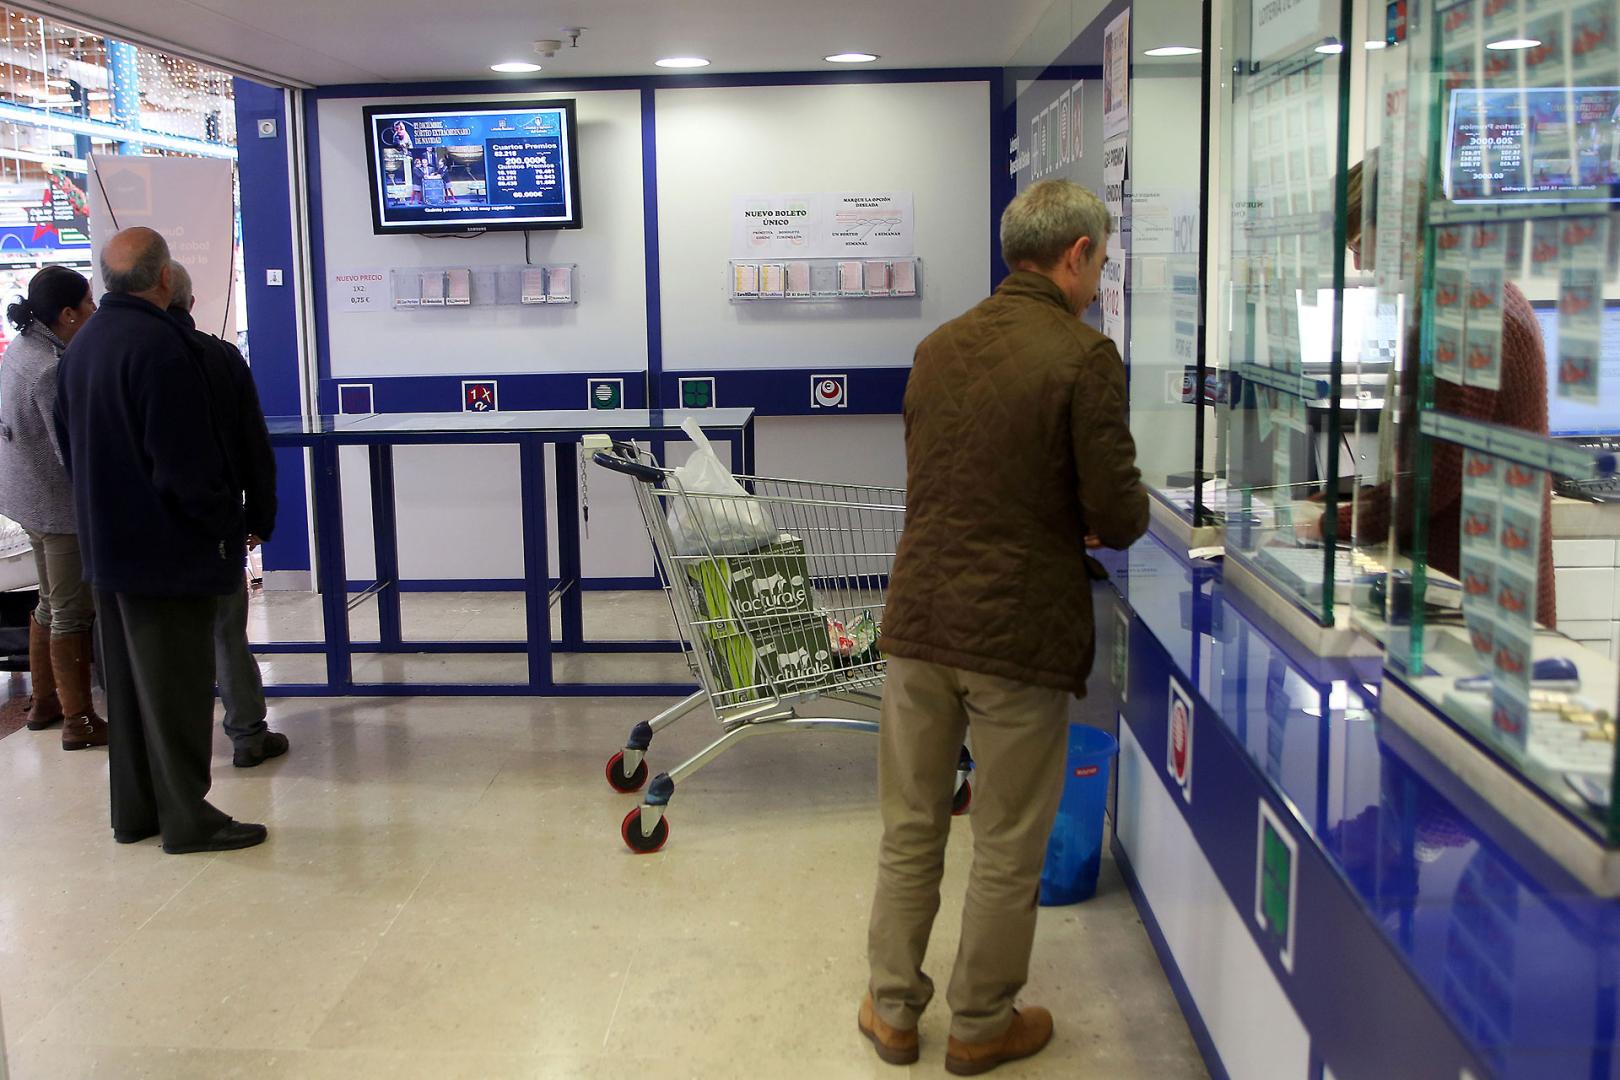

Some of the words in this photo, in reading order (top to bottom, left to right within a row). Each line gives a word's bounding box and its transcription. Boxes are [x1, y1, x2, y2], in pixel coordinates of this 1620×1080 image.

[505, 156, 547, 164] 200.000€
[762, 218, 789, 226] ÚNICO
[736, 589, 806, 613] lacturale
